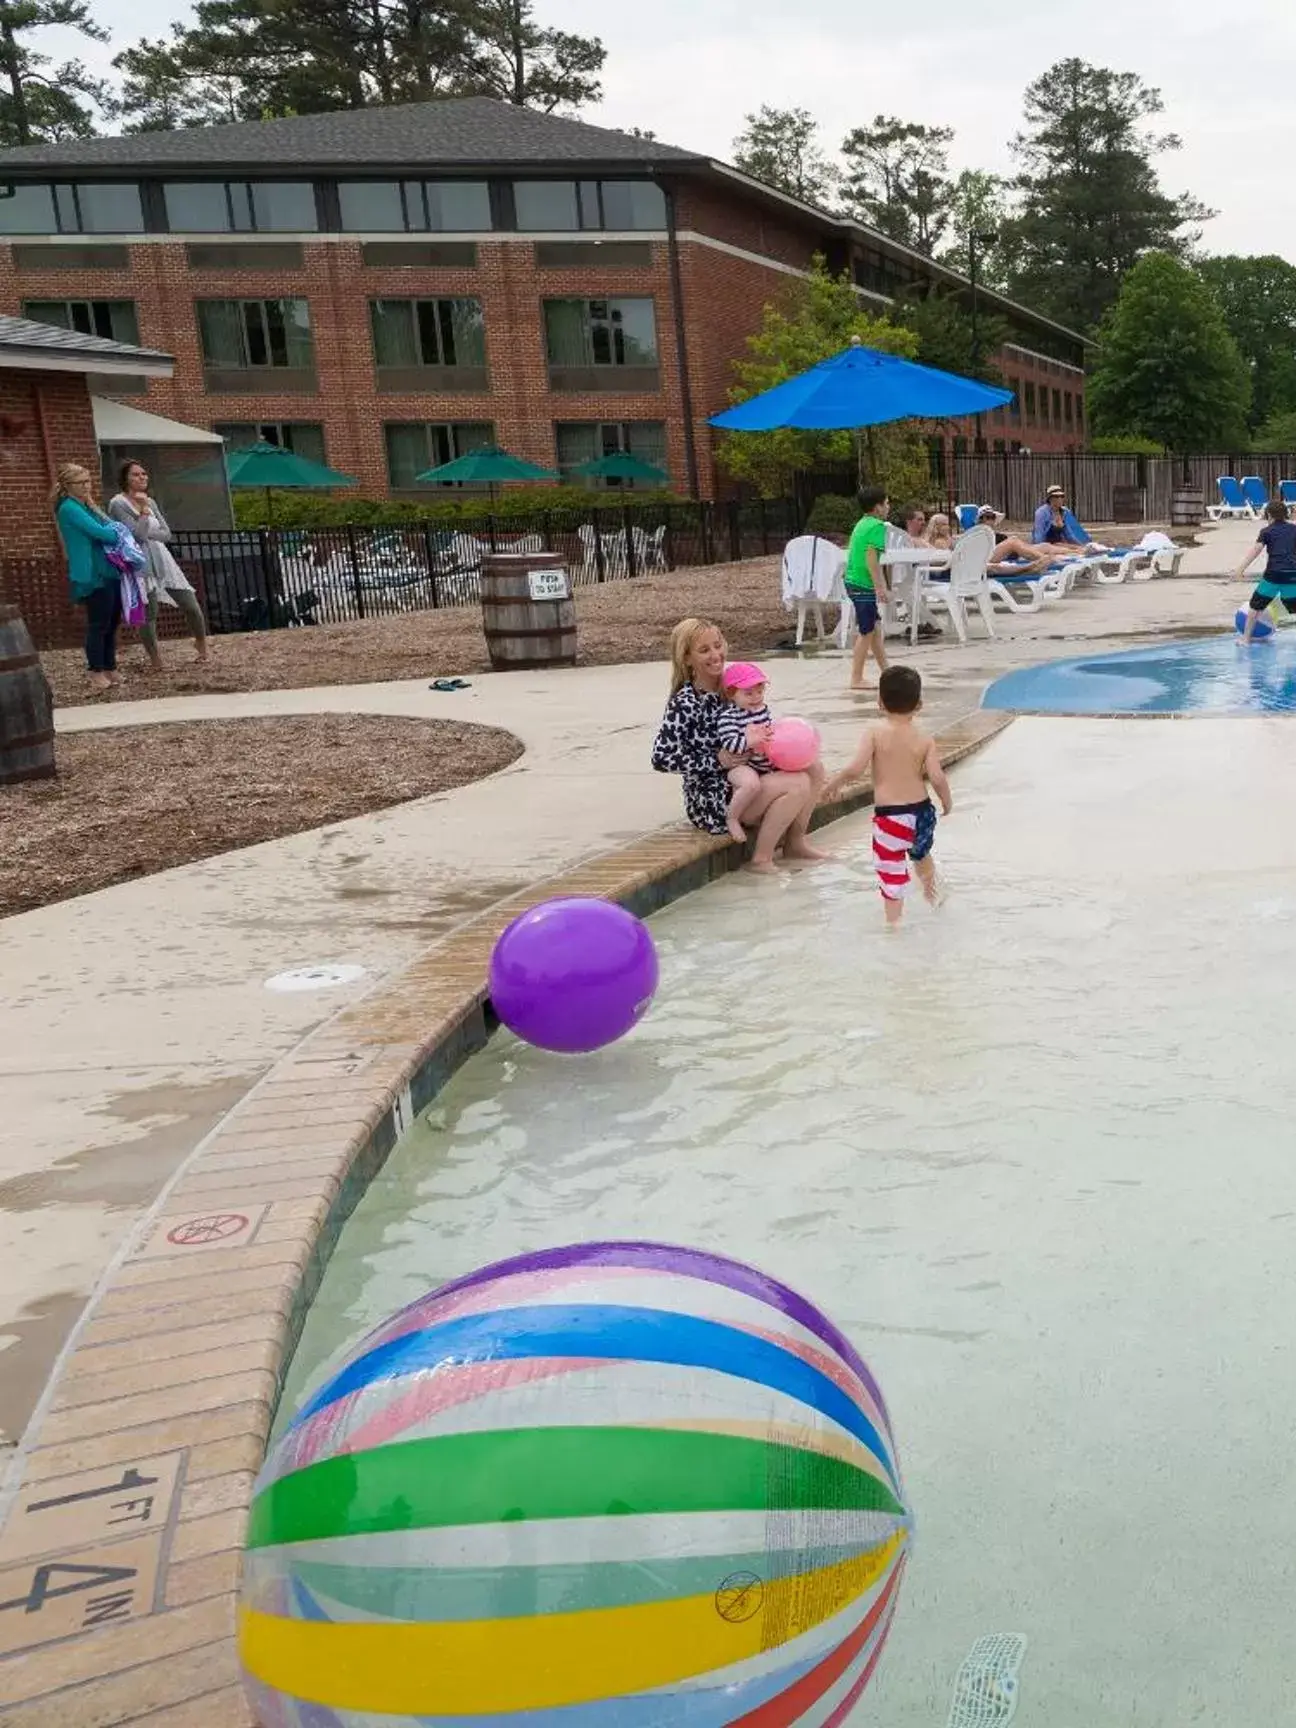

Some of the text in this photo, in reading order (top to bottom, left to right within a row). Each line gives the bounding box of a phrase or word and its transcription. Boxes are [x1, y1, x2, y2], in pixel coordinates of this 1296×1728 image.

[0, 1468, 159, 1627] 1 FT 4 IN
